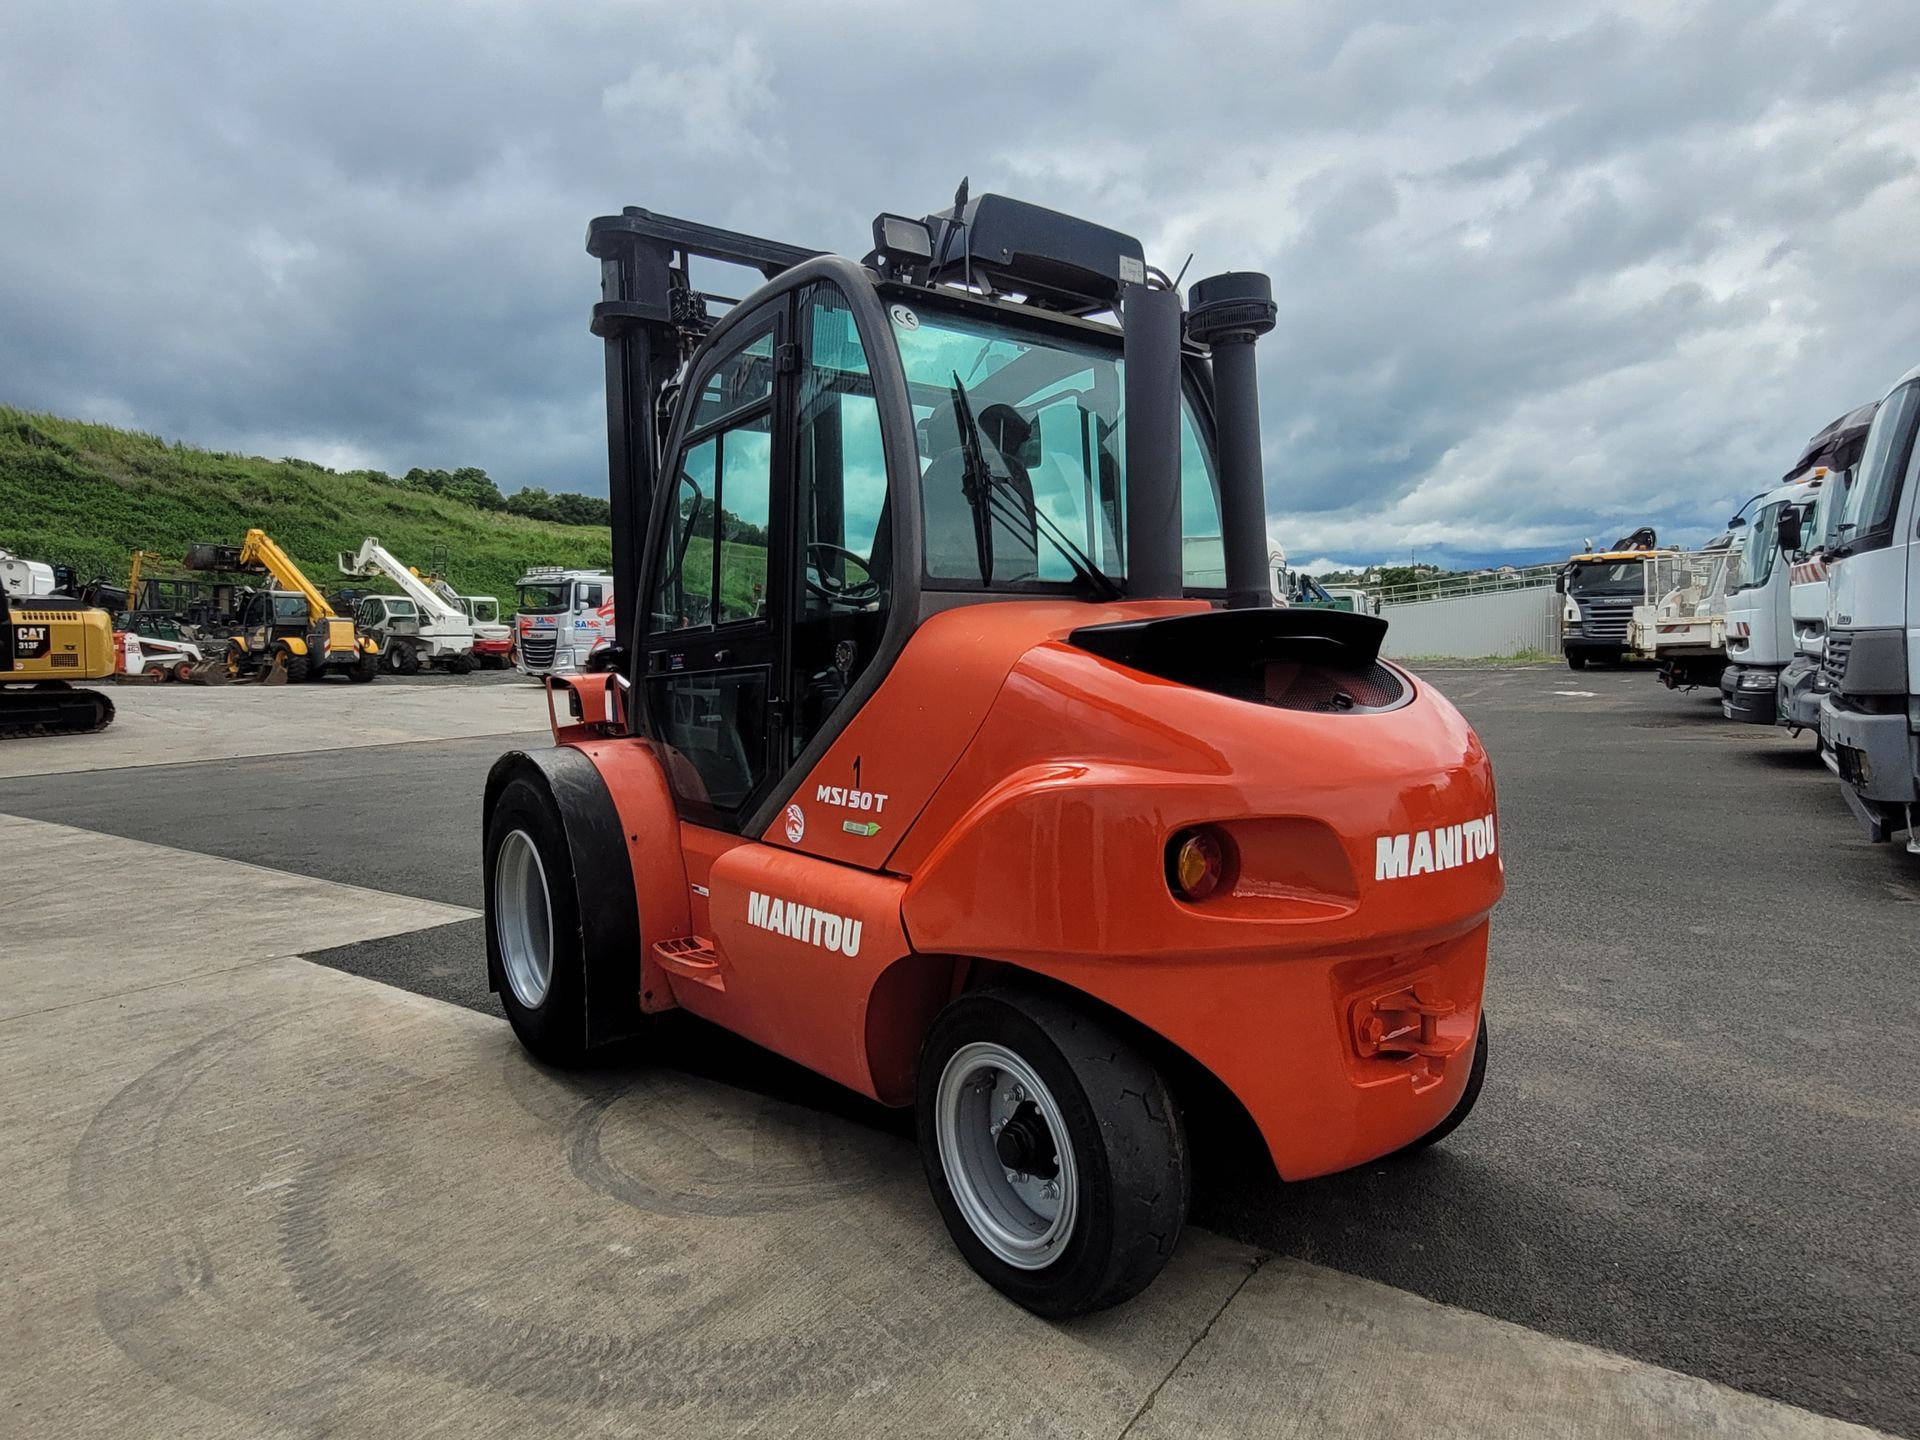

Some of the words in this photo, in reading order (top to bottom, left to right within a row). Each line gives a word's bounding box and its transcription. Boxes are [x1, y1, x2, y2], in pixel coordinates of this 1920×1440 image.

[17, 627, 46, 640] CAT
[18, 641, 39, 649] 313F
[852, 755, 862, 789] 1
[1375, 814, 1495, 880] MANITOU
[747, 891, 862, 957] MANITOU
